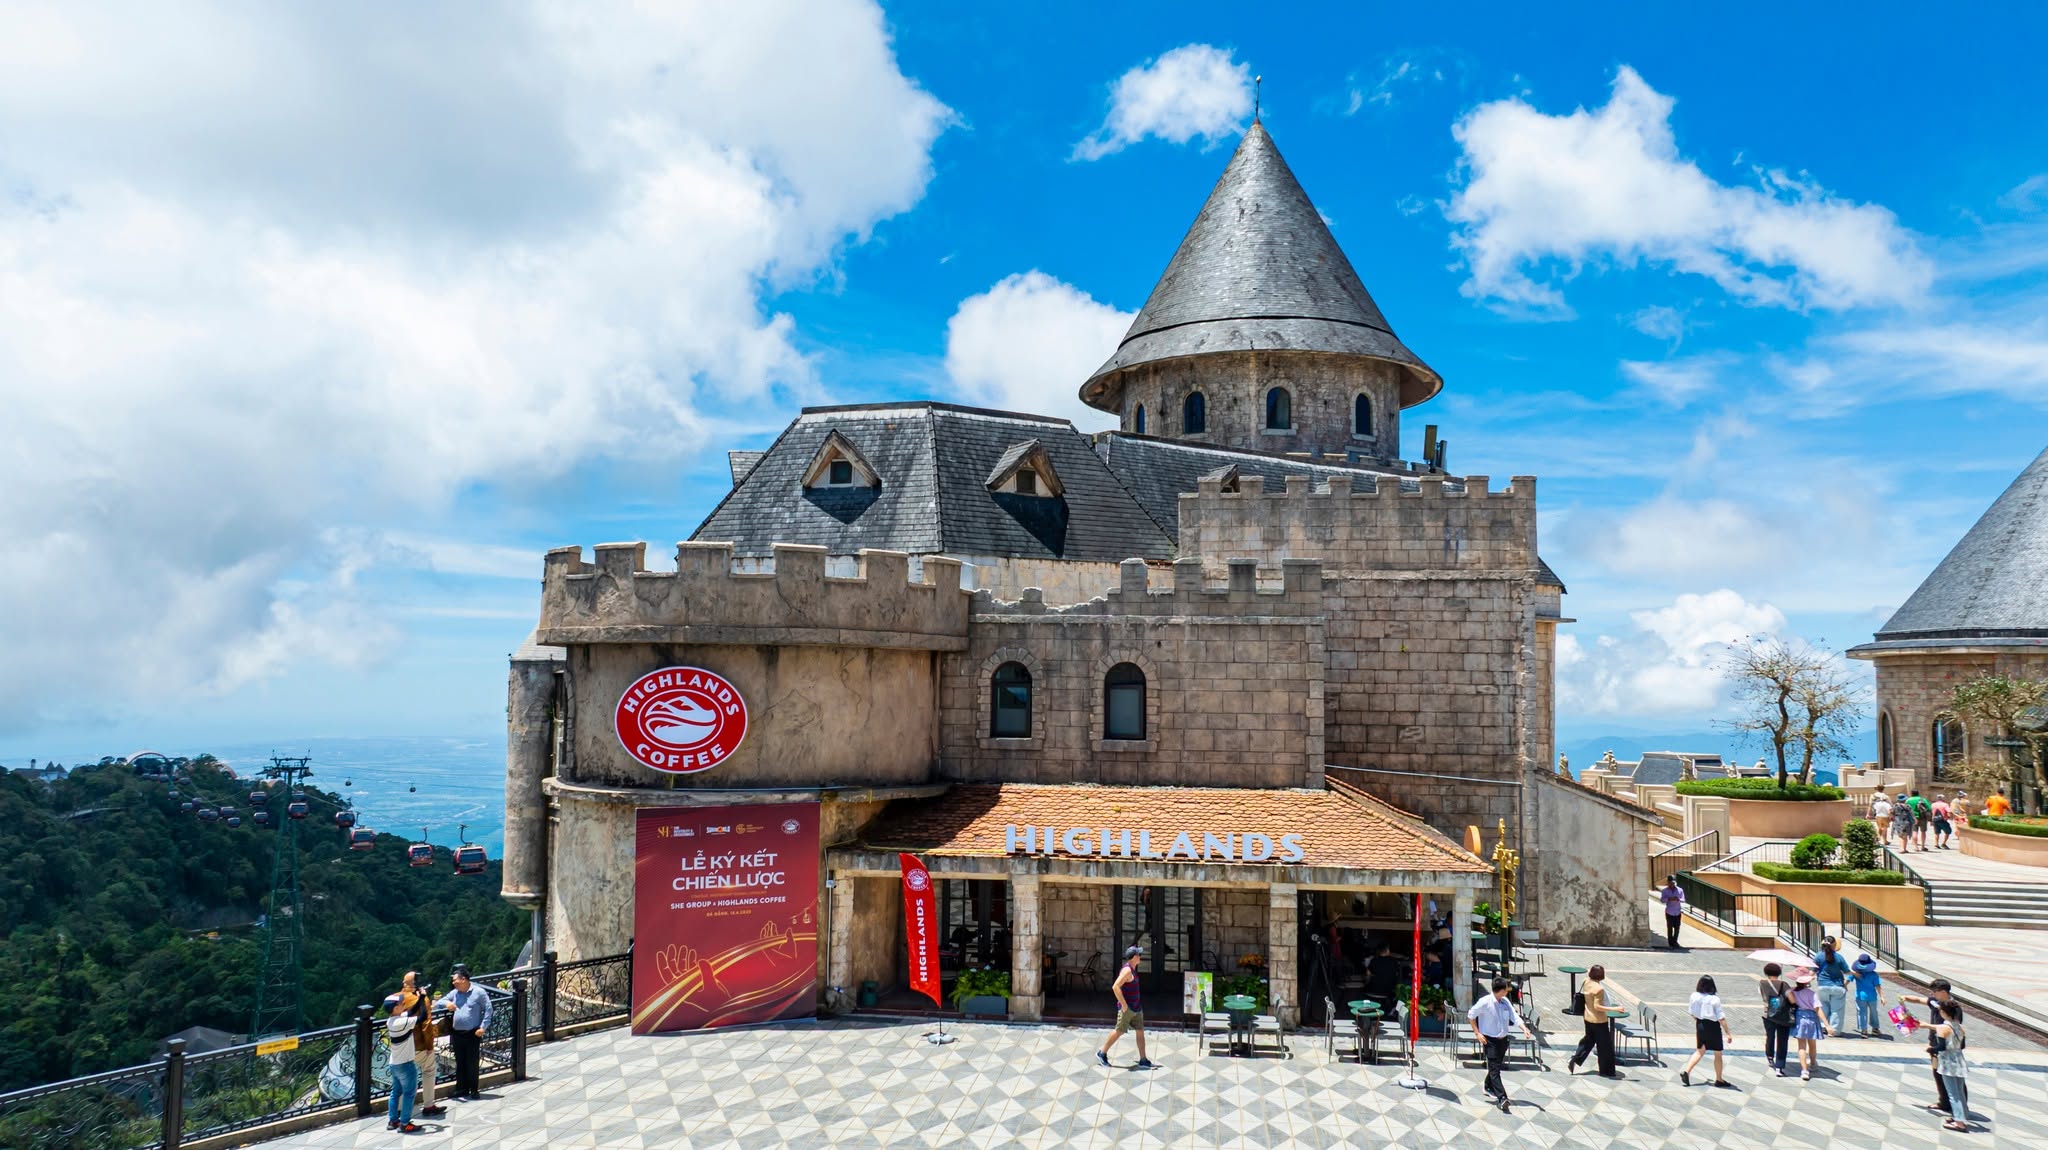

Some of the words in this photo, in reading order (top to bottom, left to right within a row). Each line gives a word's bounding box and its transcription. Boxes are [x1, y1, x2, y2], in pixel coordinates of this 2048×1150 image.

[624, 672, 739, 715] HIGHLANDS
[636, 743, 725, 768] COFFEE
[1005, 825, 1305, 863] HIGHLANDS
[681, 850, 706, 871] LỄ
[710, 850, 736, 869] KÝ
[740, 848, 778, 868] KẾT
[672, 869, 730, 891] CHIẾN
[735, 871, 785, 889] LƯỢC
[717, 897, 758, 906] HIGHLANDS
[760, 896, 786, 904] COFFEE
[916, 899, 928, 982] HIGHLANDS
